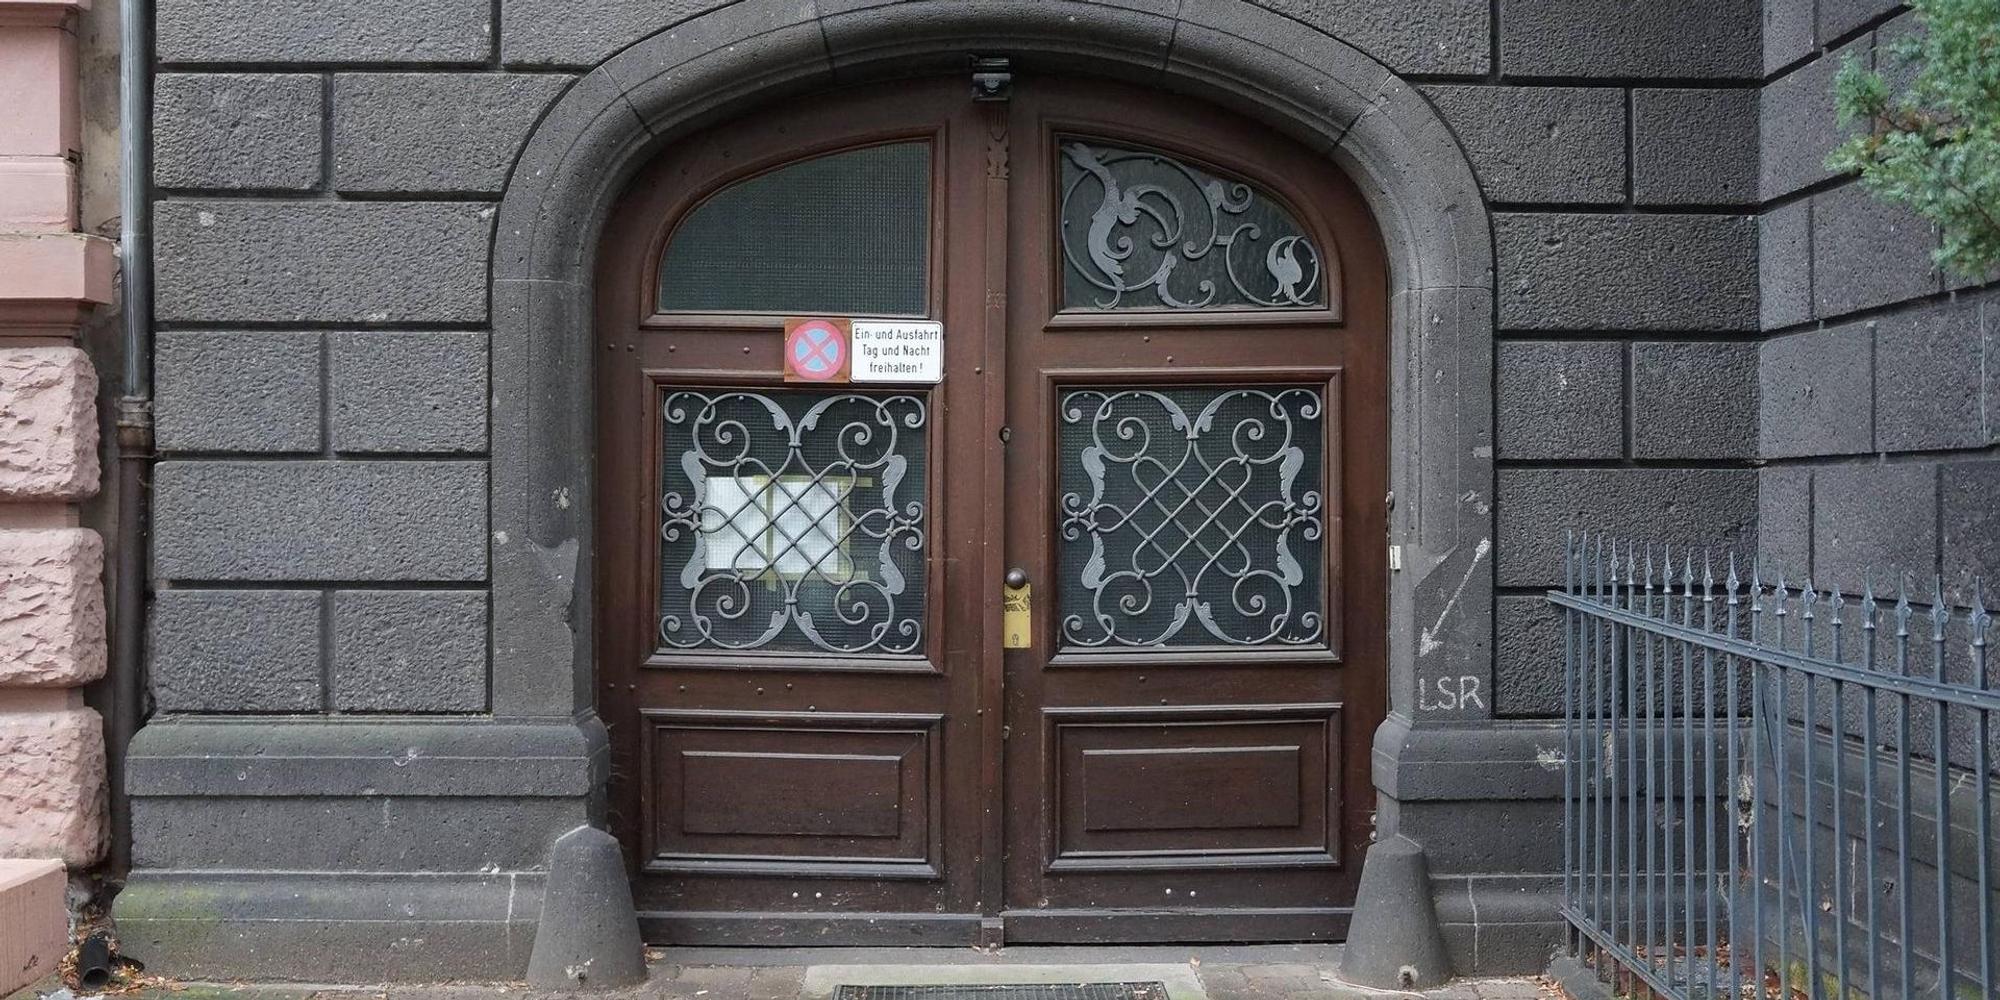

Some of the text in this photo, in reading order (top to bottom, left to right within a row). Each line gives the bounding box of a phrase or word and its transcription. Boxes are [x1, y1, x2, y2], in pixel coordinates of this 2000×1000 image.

[855, 328, 938, 340] Ein- und Ausfahrt
[863, 344, 930, 358] Tag und Nacht
[1418, 675, 1485, 711] LSR
